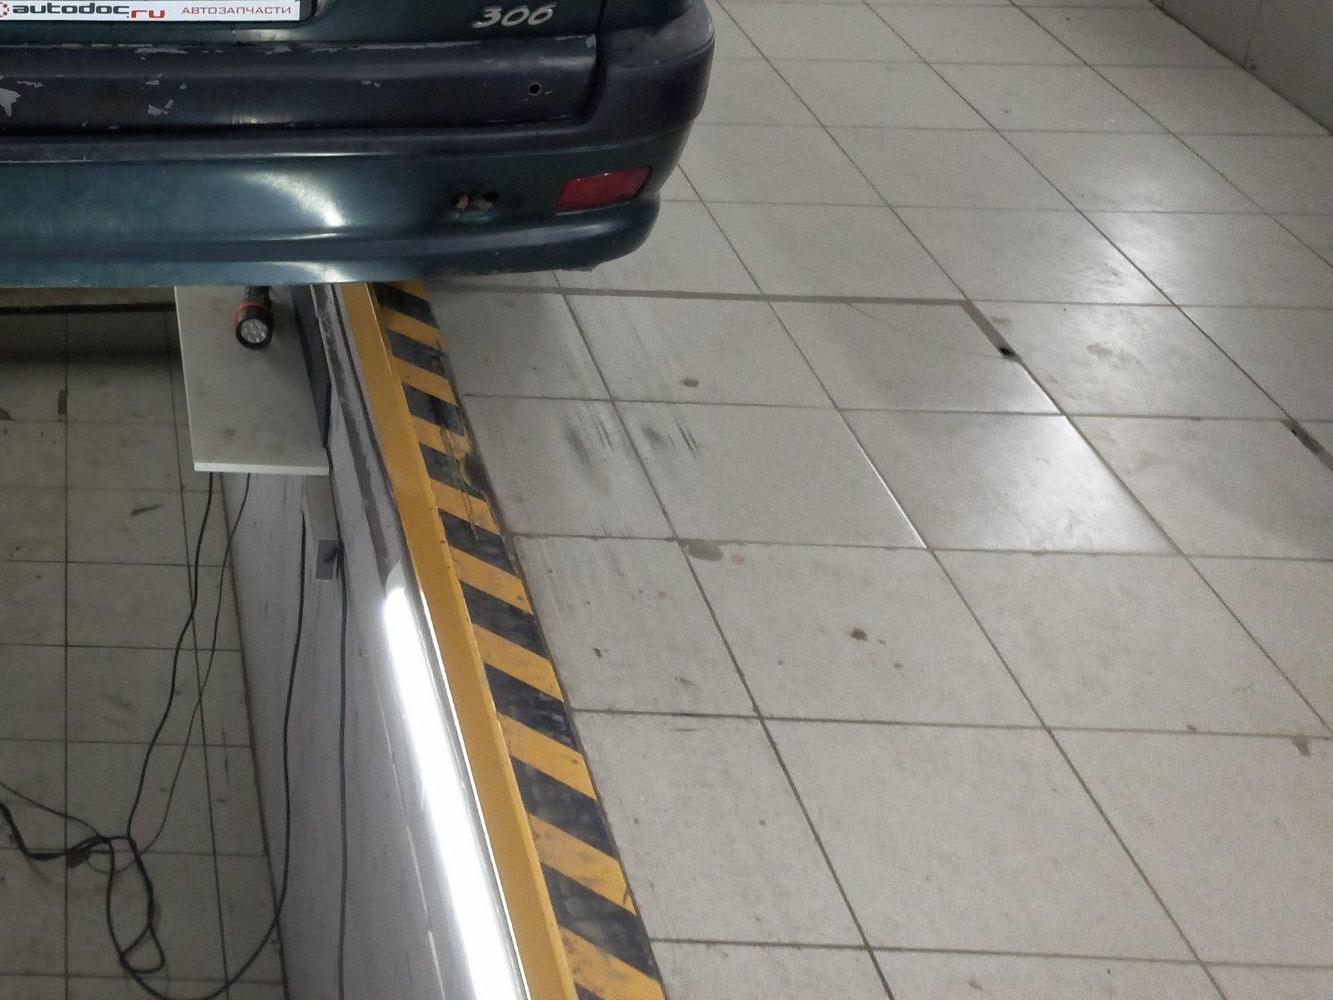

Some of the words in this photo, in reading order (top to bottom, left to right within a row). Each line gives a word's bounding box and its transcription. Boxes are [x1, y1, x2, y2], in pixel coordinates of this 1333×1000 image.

[12, 2, 166, 19] autodoc.ru
[181, 6, 292, 15] АВТОЗАПЧАСТИ
[472, 2, 557, 28] 306
